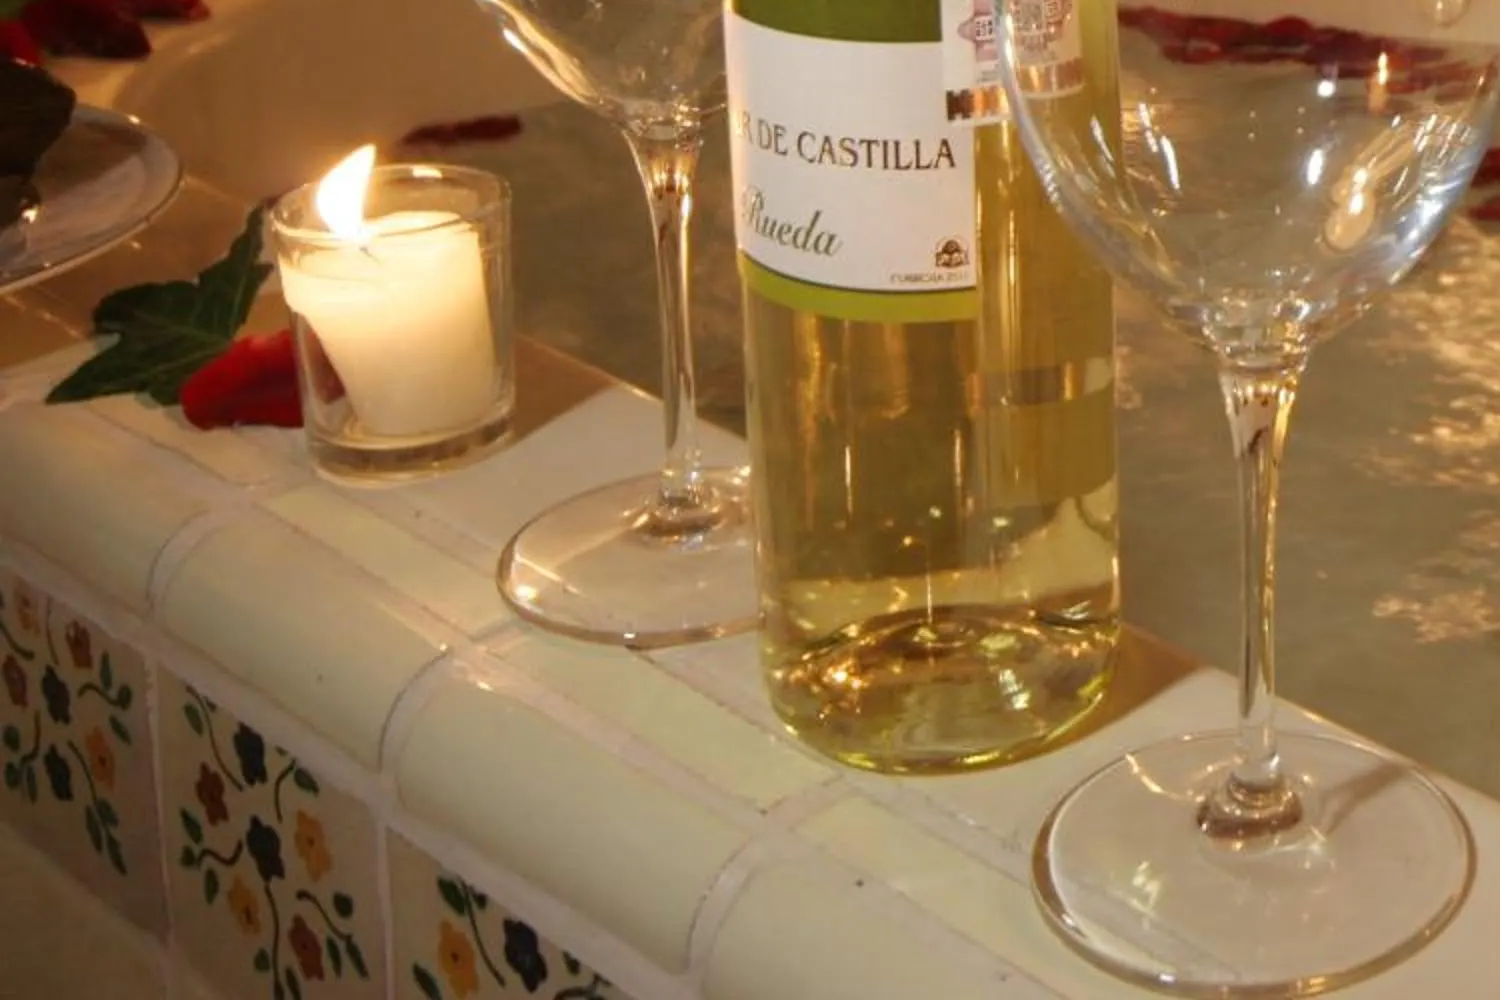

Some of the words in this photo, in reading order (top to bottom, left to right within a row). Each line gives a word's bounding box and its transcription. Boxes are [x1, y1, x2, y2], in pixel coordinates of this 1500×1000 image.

[757, 117, 788, 157] DE
[797, 130, 957, 171] CASTILLA
[743, 184, 844, 258] Rueda
